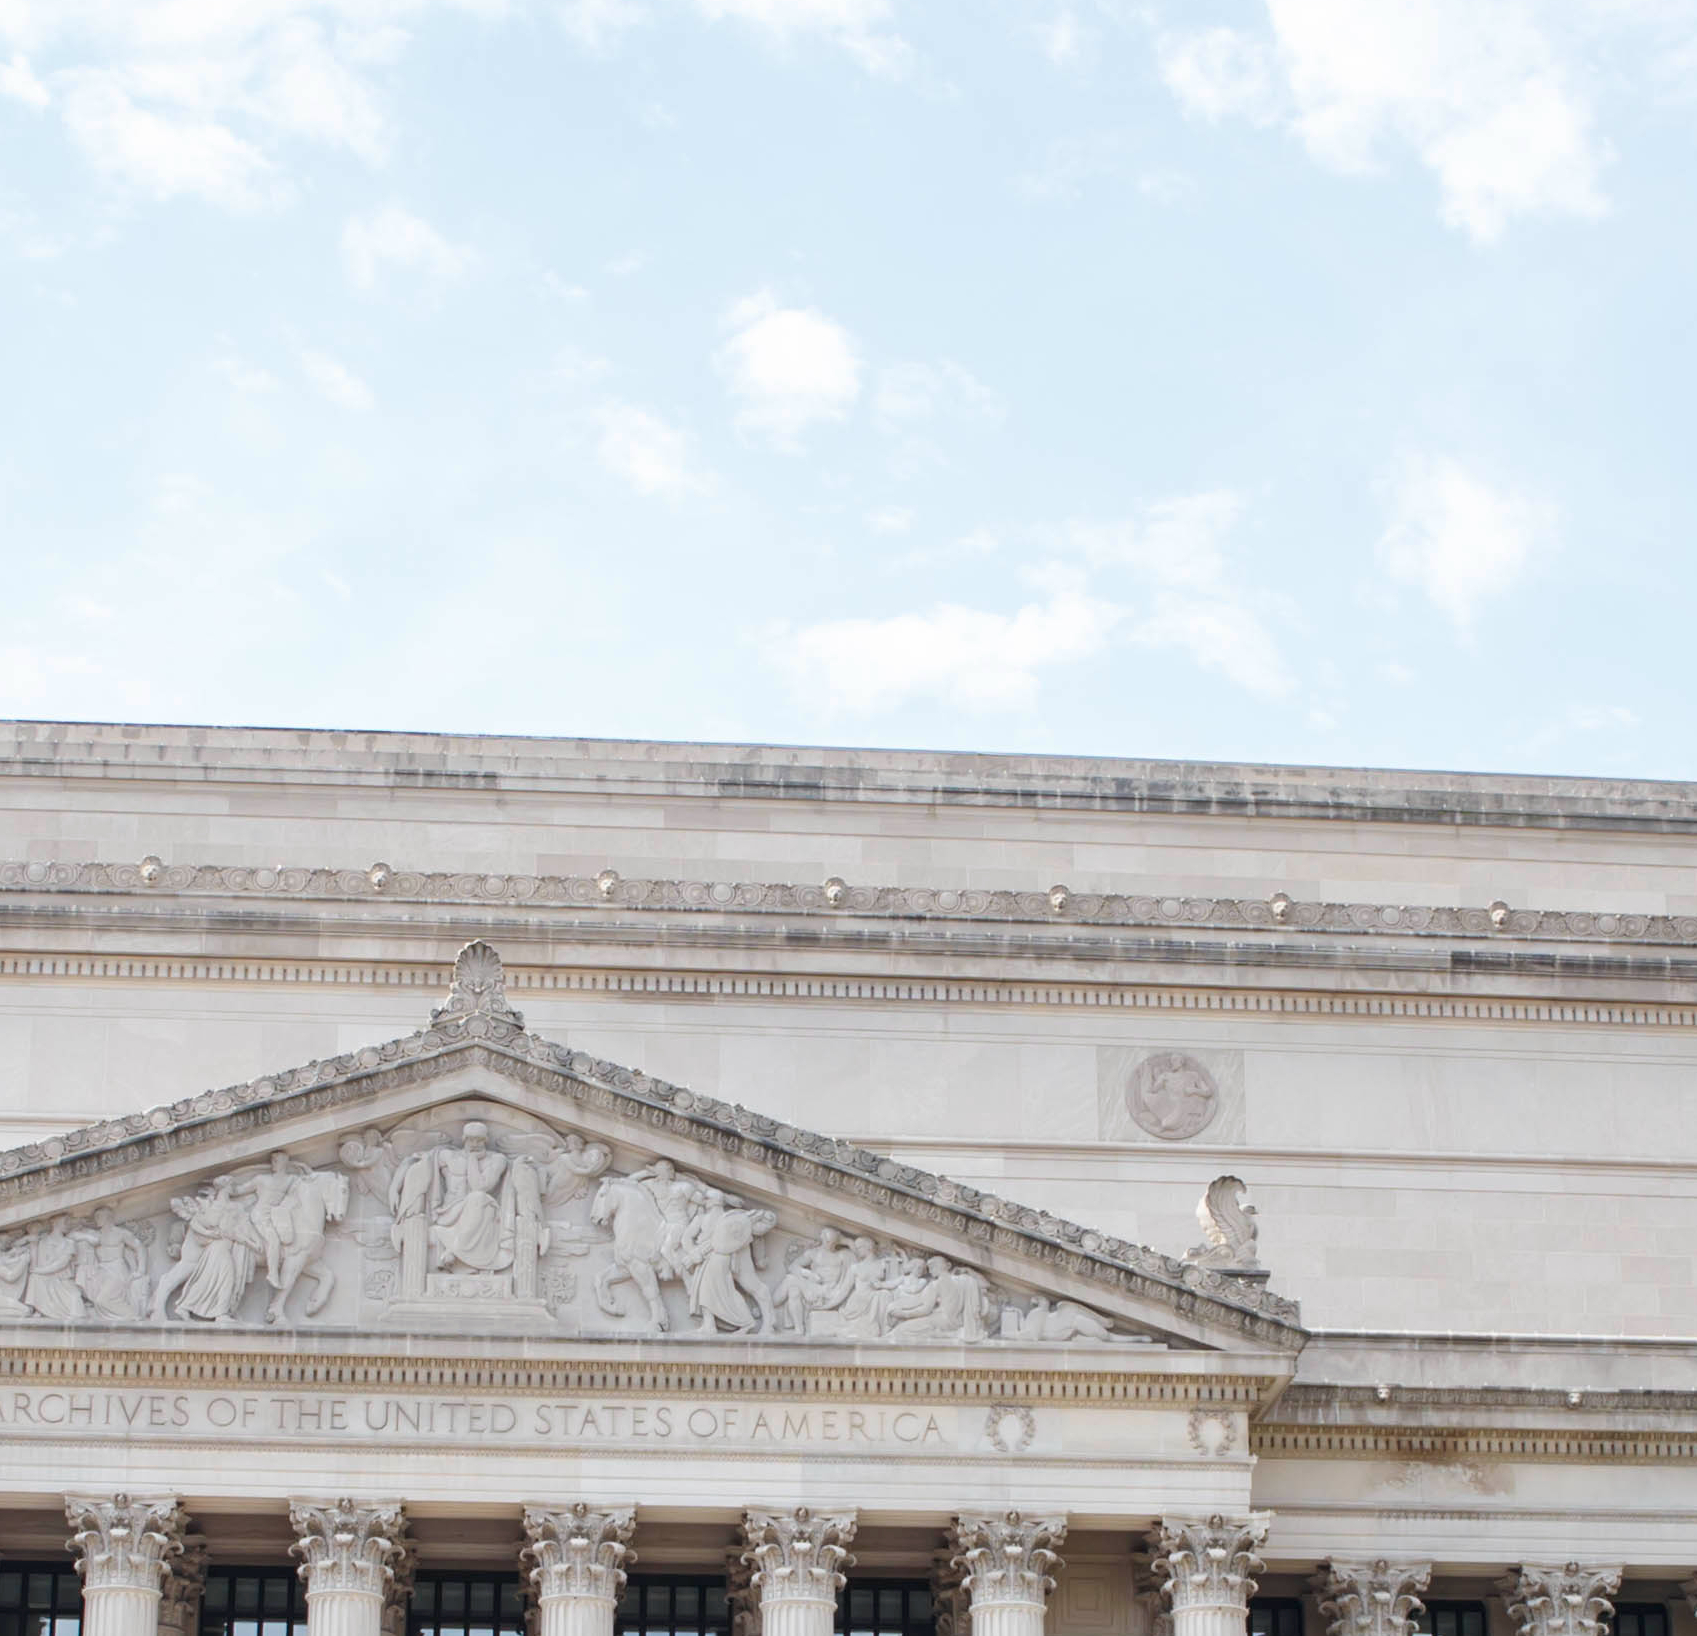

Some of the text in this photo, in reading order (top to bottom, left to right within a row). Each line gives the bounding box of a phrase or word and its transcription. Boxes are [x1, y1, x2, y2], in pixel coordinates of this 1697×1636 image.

[207, 1397, 258, 1428] OF
[271, 1399, 348, 1431] THE
[365, 1401, 516, 1434] UNITED
[534, 1405, 672, 1438] STATES
[688, 1408, 739, 1439] OF
[751, 1411, 948, 1443] AMERICA
